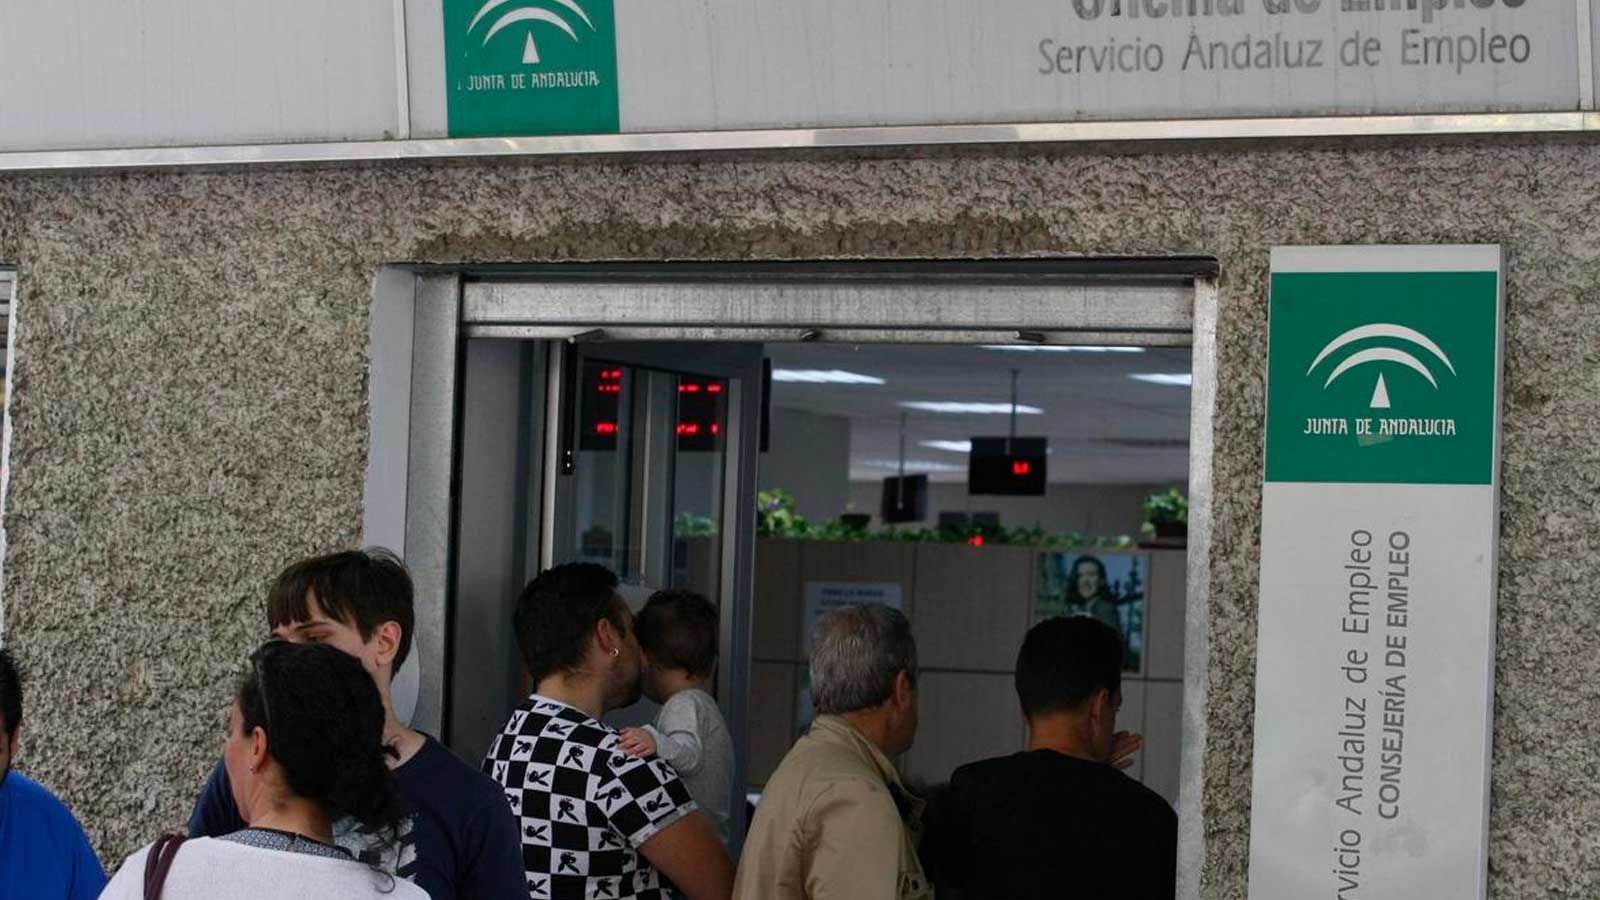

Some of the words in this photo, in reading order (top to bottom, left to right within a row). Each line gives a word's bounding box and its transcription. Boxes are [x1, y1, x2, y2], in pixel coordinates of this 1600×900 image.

[1038, 36, 1164, 74] Servicio
[1181, 32, 1324, 71] Andaluz
[1340, 30, 1382, 67] de
[1401, 27, 1531, 75] Empleo
[466, 74, 505, 91] JUNTA
[511, 73, 526, 89] DE
[531, 71, 599, 88] ANDALUCIA
[1303, 418, 1348, 435] JUNTA
[1356, 418, 1373, 435] DE
[1379, 418, 1457, 436] ANDALUCIA
[1342, 529, 1379, 634] Empleo
[1386, 531, 1411, 628] EMPLEO
[1341, 649, 1369, 684] de
[1385, 635, 1407, 667] DE
[1335, 697, 1367, 816] Andaluz
[1377, 675, 1407, 820] CONSEJERÍA
